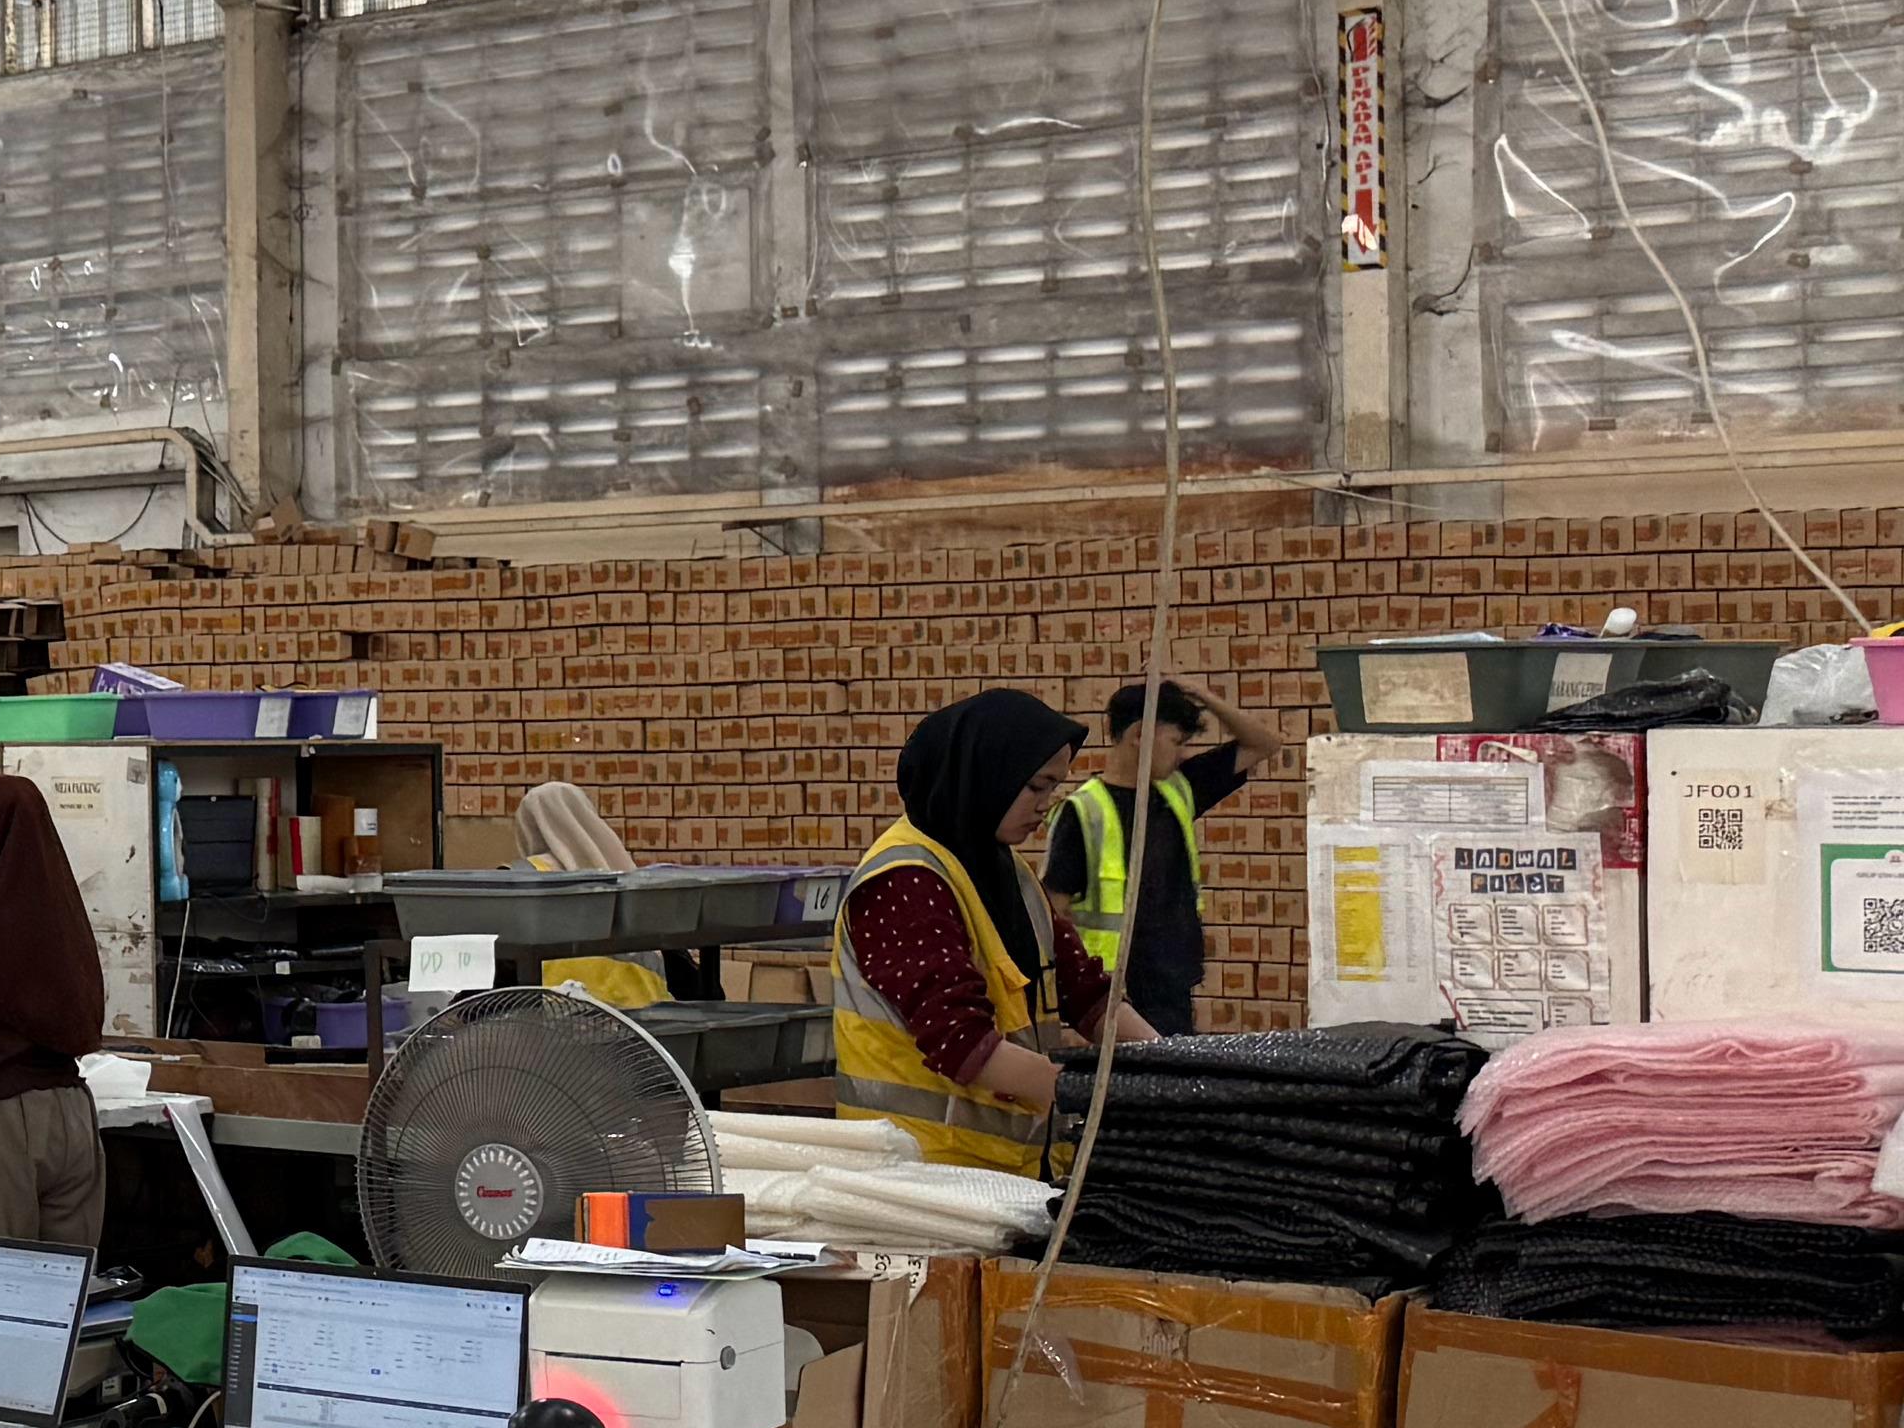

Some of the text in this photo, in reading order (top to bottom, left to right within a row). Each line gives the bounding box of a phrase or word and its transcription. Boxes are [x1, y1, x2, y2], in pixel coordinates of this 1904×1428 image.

[1351, 66, 1373, 185] PEMADAM API
[1684, 784, 1753, 799] JF001
[1457, 849, 1576, 869] JADWAL
[1472, 874, 1564, 892] PIKET
[814, 885, 831, 910] 16
[420, 951, 471, 974] DD 10
